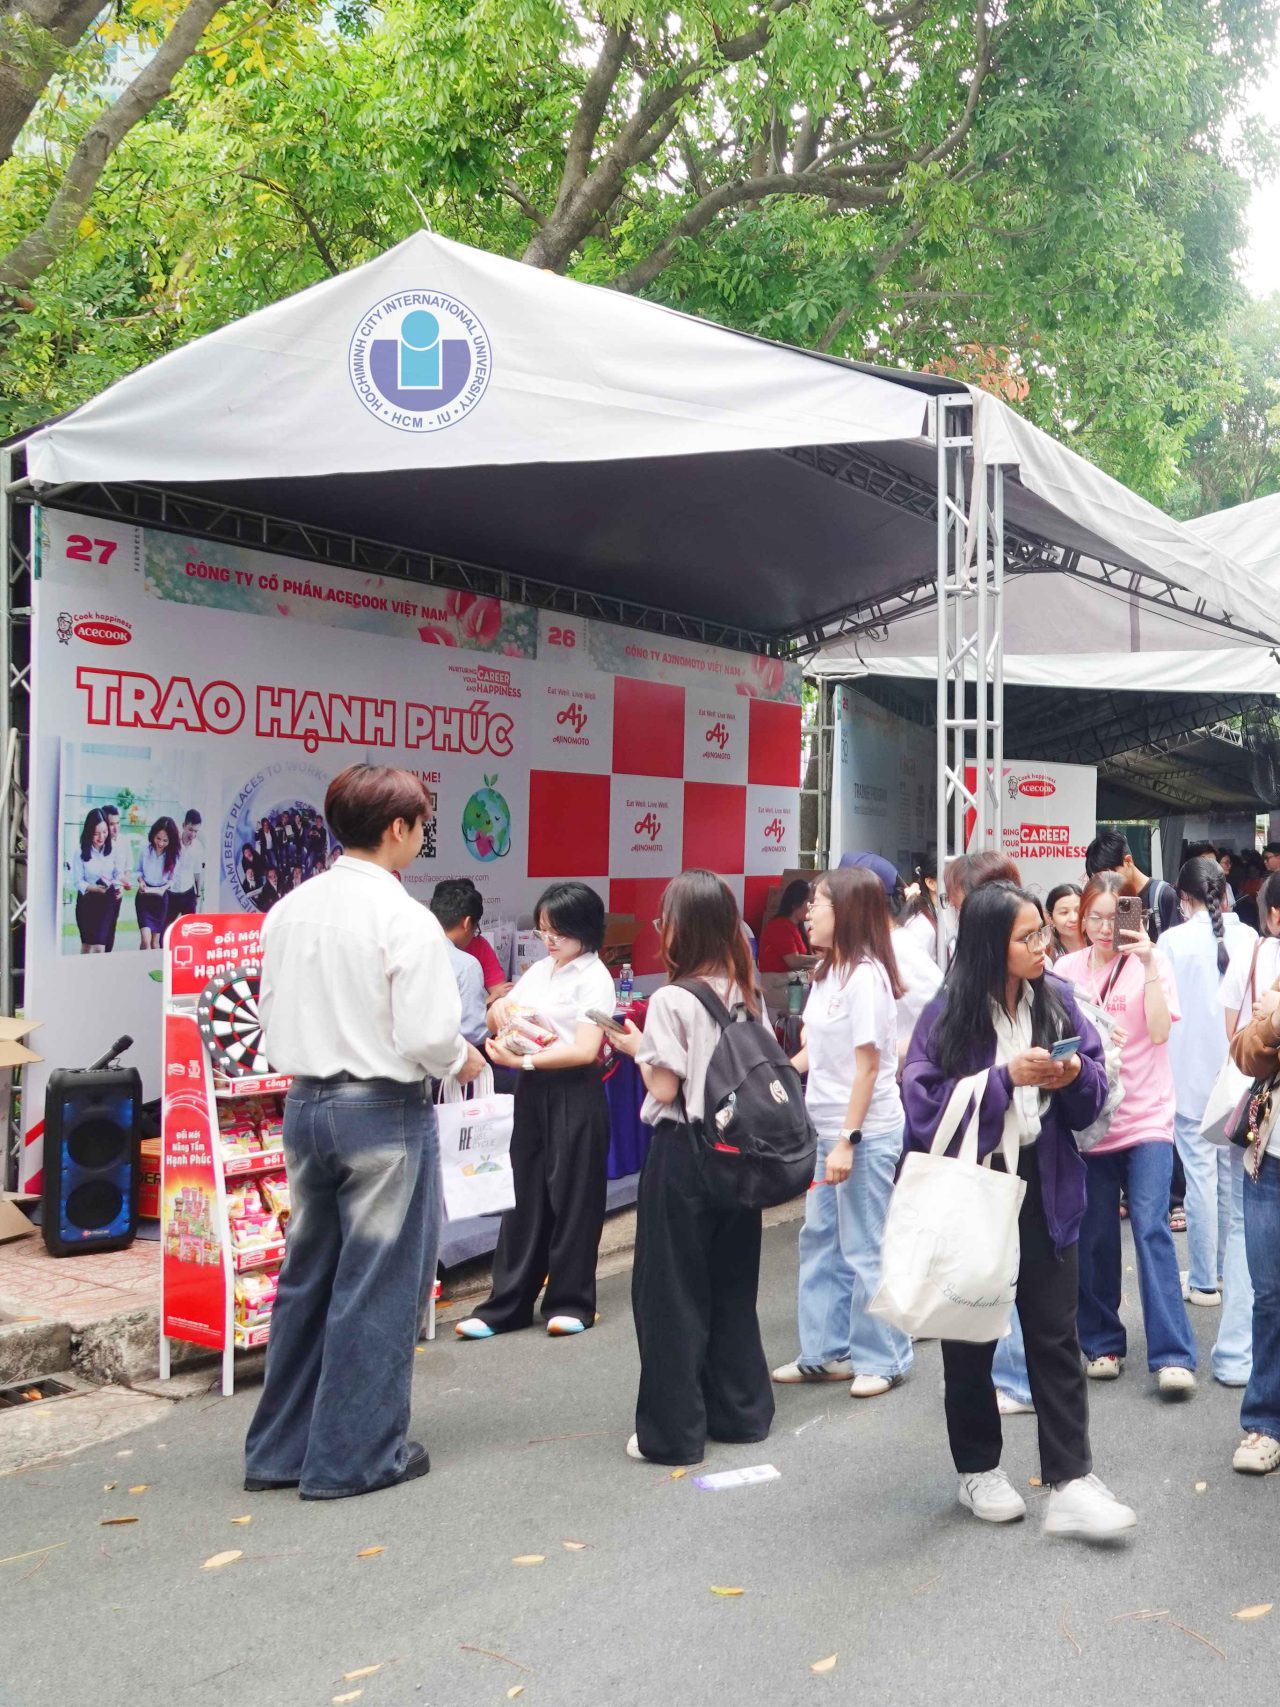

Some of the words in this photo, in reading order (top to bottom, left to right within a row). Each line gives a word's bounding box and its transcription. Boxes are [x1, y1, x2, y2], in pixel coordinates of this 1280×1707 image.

[361, 310, 384, 337] CITY
[382, 294, 477, 336] INTERNATIONAL
[353, 339, 383, 411] HOCHIMINH
[459, 335, 487, 411] UNIVERSITY
[391, 412, 423, 428] HCM
[437, 411, 451, 425] IU
[66, 534, 118, 565] 27
[185, 561, 230, 583] CÔNG
[235, 571, 254, 587] TY
[327, 588, 388, 611] ACECOOK
[392, 599, 418, 618] VIỆT
[421, 605, 448, 622] NAM
[74, 612, 93, 622] Cook
[95, 611, 132, 630] happiness
[547, 626, 576, 648] 26
[650, 650, 661, 662] TY
[662, 653, 705, 672] AJINOMOTO
[724, 666, 740, 677] NAM
[477, 669, 510, 684] CAREER
[476, 684, 522, 698] HAPPINESS
[76, 666, 245, 735] TRAO
[255, 684, 397, 753] HẠNH
[405, 699, 514, 757] PHÚC
[267, 763, 282, 777] TO
[422, 772, 440, 782] ME!
[230, 774, 265, 819] PLACES
[224, 824, 235, 859] BEST
[1021, 829, 1068, 842] CAREER
[1020, 845, 1087, 858] HAPPINESS
[225, 866, 257, 913] IETNAM
[214, 931, 235, 945] Đổi
[238, 929, 259, 942] Mới
[206, 947, 239, 960] Nâng
[458, 1126, 473, 1152] RE
[166, 1155, 188, 1168] Hạnh
[190, 1153, 212, 1165] Phúc
